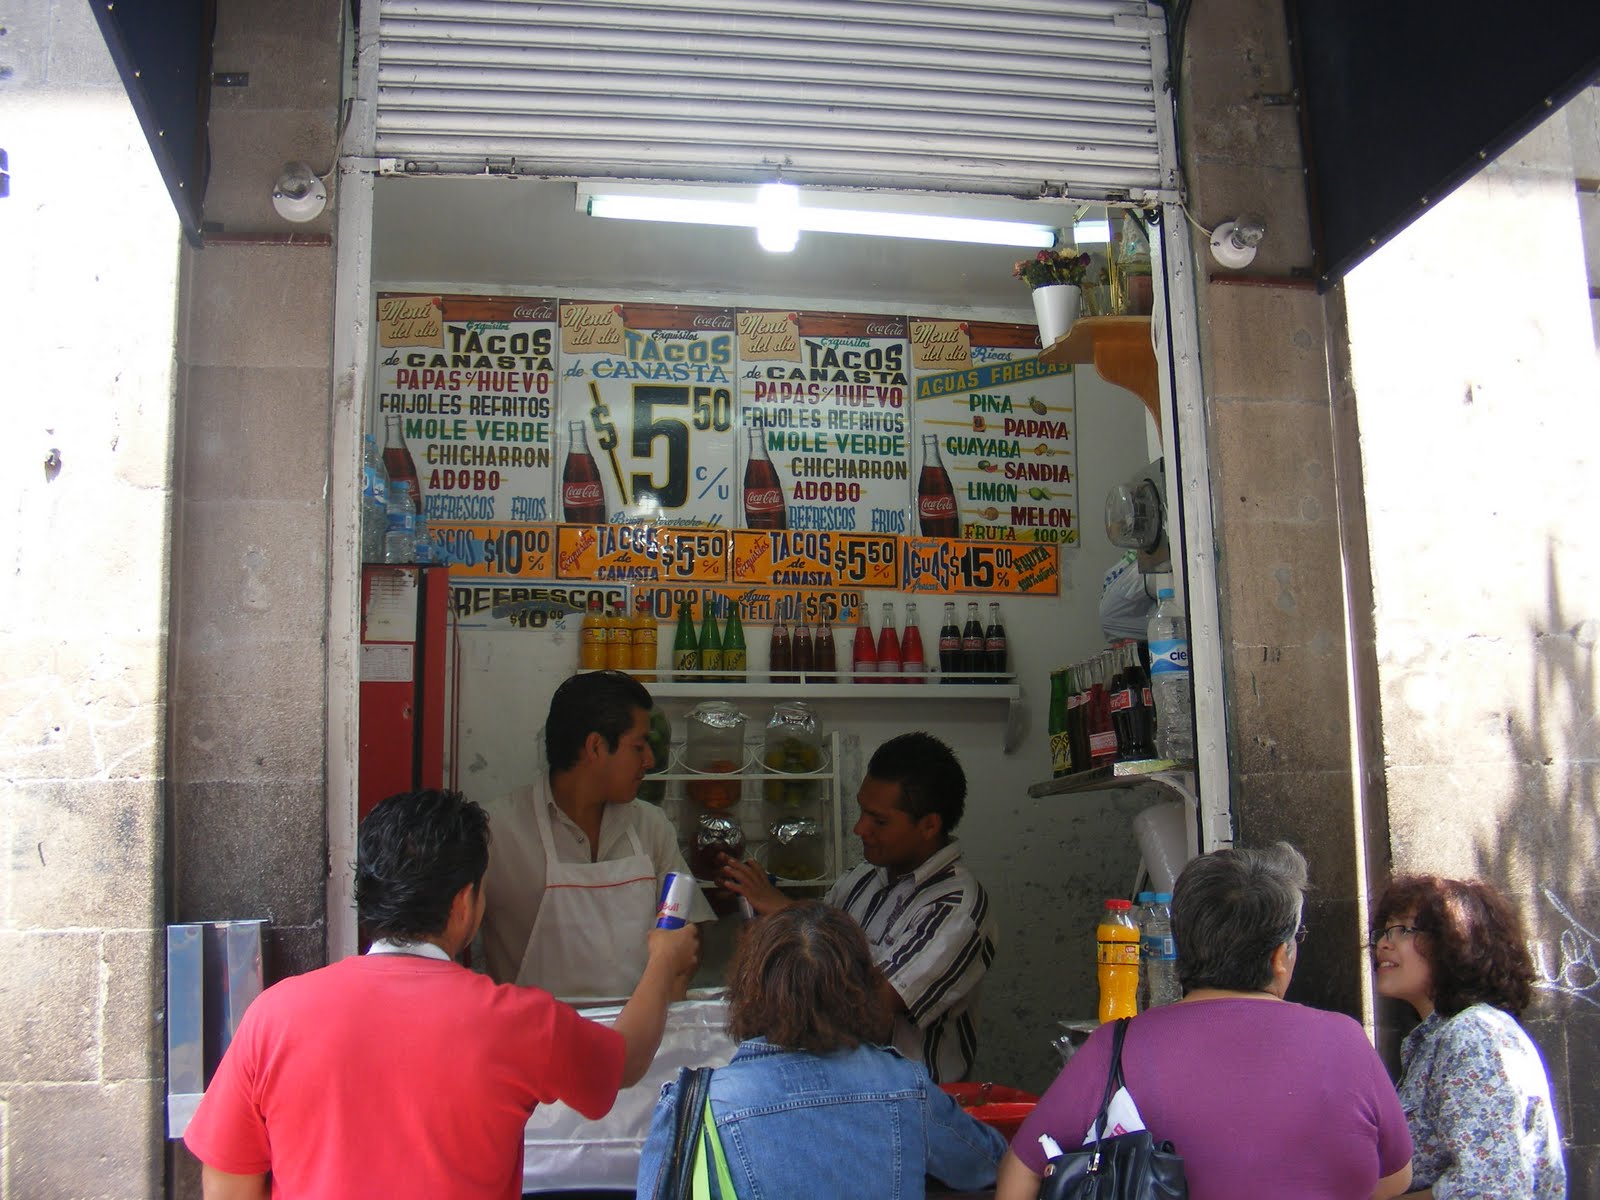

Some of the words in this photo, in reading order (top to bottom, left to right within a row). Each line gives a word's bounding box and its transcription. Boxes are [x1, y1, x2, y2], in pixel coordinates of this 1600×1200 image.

[381, 301, 431, 324] Menú
[564, 307, 612, 332] Menú
[389, 321, 411, 338] del
[572, 329, 592, 345] del
[651, 329, 698, 343] Exquisitos
[740, 315, 787, 339] Menú
[913, 325, 959, 348] Menú
[448, 325, 552, 355] TACOS
[624, 329, 731, 365] TACOS
[748, 337, 768, 353] del
[821, 337, 871, 350] Exquisitos
[382, 350, 400, 366] de
[407, 354, 553, 371] CANASTA
[806, 339, 902, 371] TACOS
[922, 346, 941, 361] del
[971, 346, 1013, 362] Ricas
[397, 369, 461, 391] PAPAS
[564, 360, 584, 378] de
[592, 358, 729, 383] CANASTA
[742, 365, 761, 379] de
[767, 367, 908, 385] CANASTA
[755, 381, 820, 405] PAPAS
[921, 371, 979, 397] AGUAS
[380, 393, 461, 415] FRIJOLES
[470, 396, 550, 418] REFRITOS
[969, 394, 1013, 414] PIÑA
[406, 418, 467, 440] MOLE
[476, 420, 549, 442] VERDE
[742, 407, 821, 428] FRIJOLES
[828, 409, 904, 433] REFRITOS
[1005, 418, 1068, 440] PAPAYA
[768, 431, 827, 453] MOLE
[835, 433, 904, 456] VERDE
[947, 437, 1021, 458] GUAYABA
[427, 444, 549, 468] CHICHARRON
[429, 469, 500, 490] ADOBO
[792, 457, 907, 480] CHICHARRON
[1005, 462, 1070, 483] SANDIA
[793, 481, 861, 502] ADOBO
[968, 482, 1017, 502] LIMON
[424, 494, 494, 521] REFRESCOS
[511, 496, 546, 521] FRIOS
[1011, 506, 1071, 527] MELON
[789, 505, 855, 531] REFRESCOS
[872, 507, 905, 533] FRIOS
[597, 526, 658, 560] TACOS
[964, 524, 1016, 541] FRUTA
[1034, 529, 1074, 543] 100%
[613, 553, 631, 563] de
[769, 532, 830, 565] TACOS
[598, 566, 659, 582] CANASTA
[787, 558, 805, 569] de
[903, 541, 949, 591] AGUAS
[772, 570, 832, 586] CANASTA
[738, 589, 771, 607] Agua
